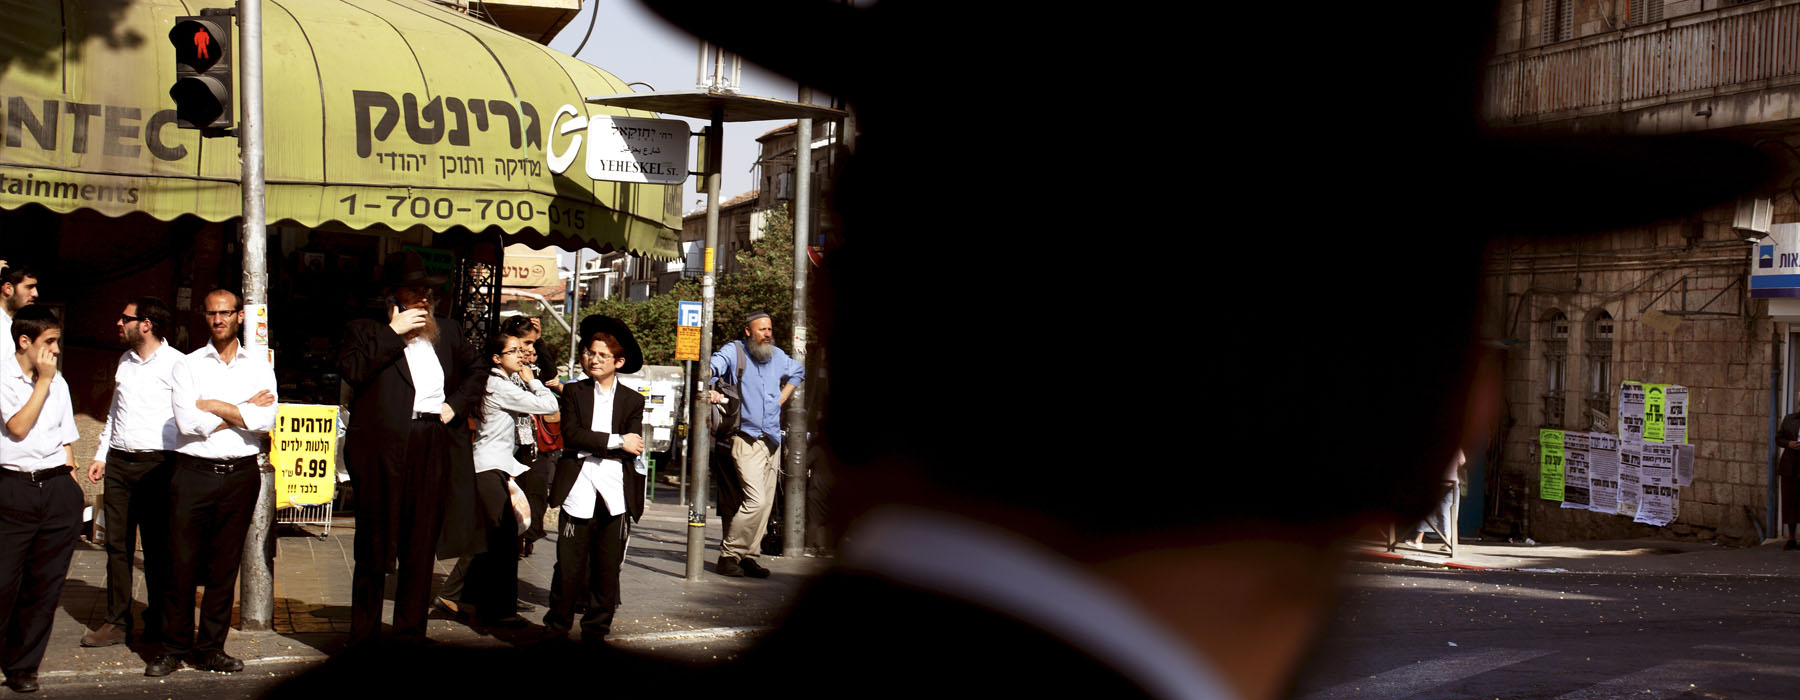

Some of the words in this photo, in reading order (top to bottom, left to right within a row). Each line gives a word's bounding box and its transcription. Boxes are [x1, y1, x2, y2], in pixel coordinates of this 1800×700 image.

[0, 96, 188, 161] NTEC
[352, 89, 542, 158] גרינטק
[376, 151, 426, 172] יהודי
[439, 154, 484, 180] ותוכן
[600, 159, 664, 176] YEHESKEL
[666, 167, 679, 177] ST.
[339, 193, 586, 230] 1-700-700-015
[1779, 252, 1800, 269] אות
[291, 417, 333, 433] מדהים
[281, 438, 303, 452] ילדים
[305, 439, 330, 454] קלטות
[294, 457, 327, 478] 6.99
[300, 484, 318, 494] בלבד
